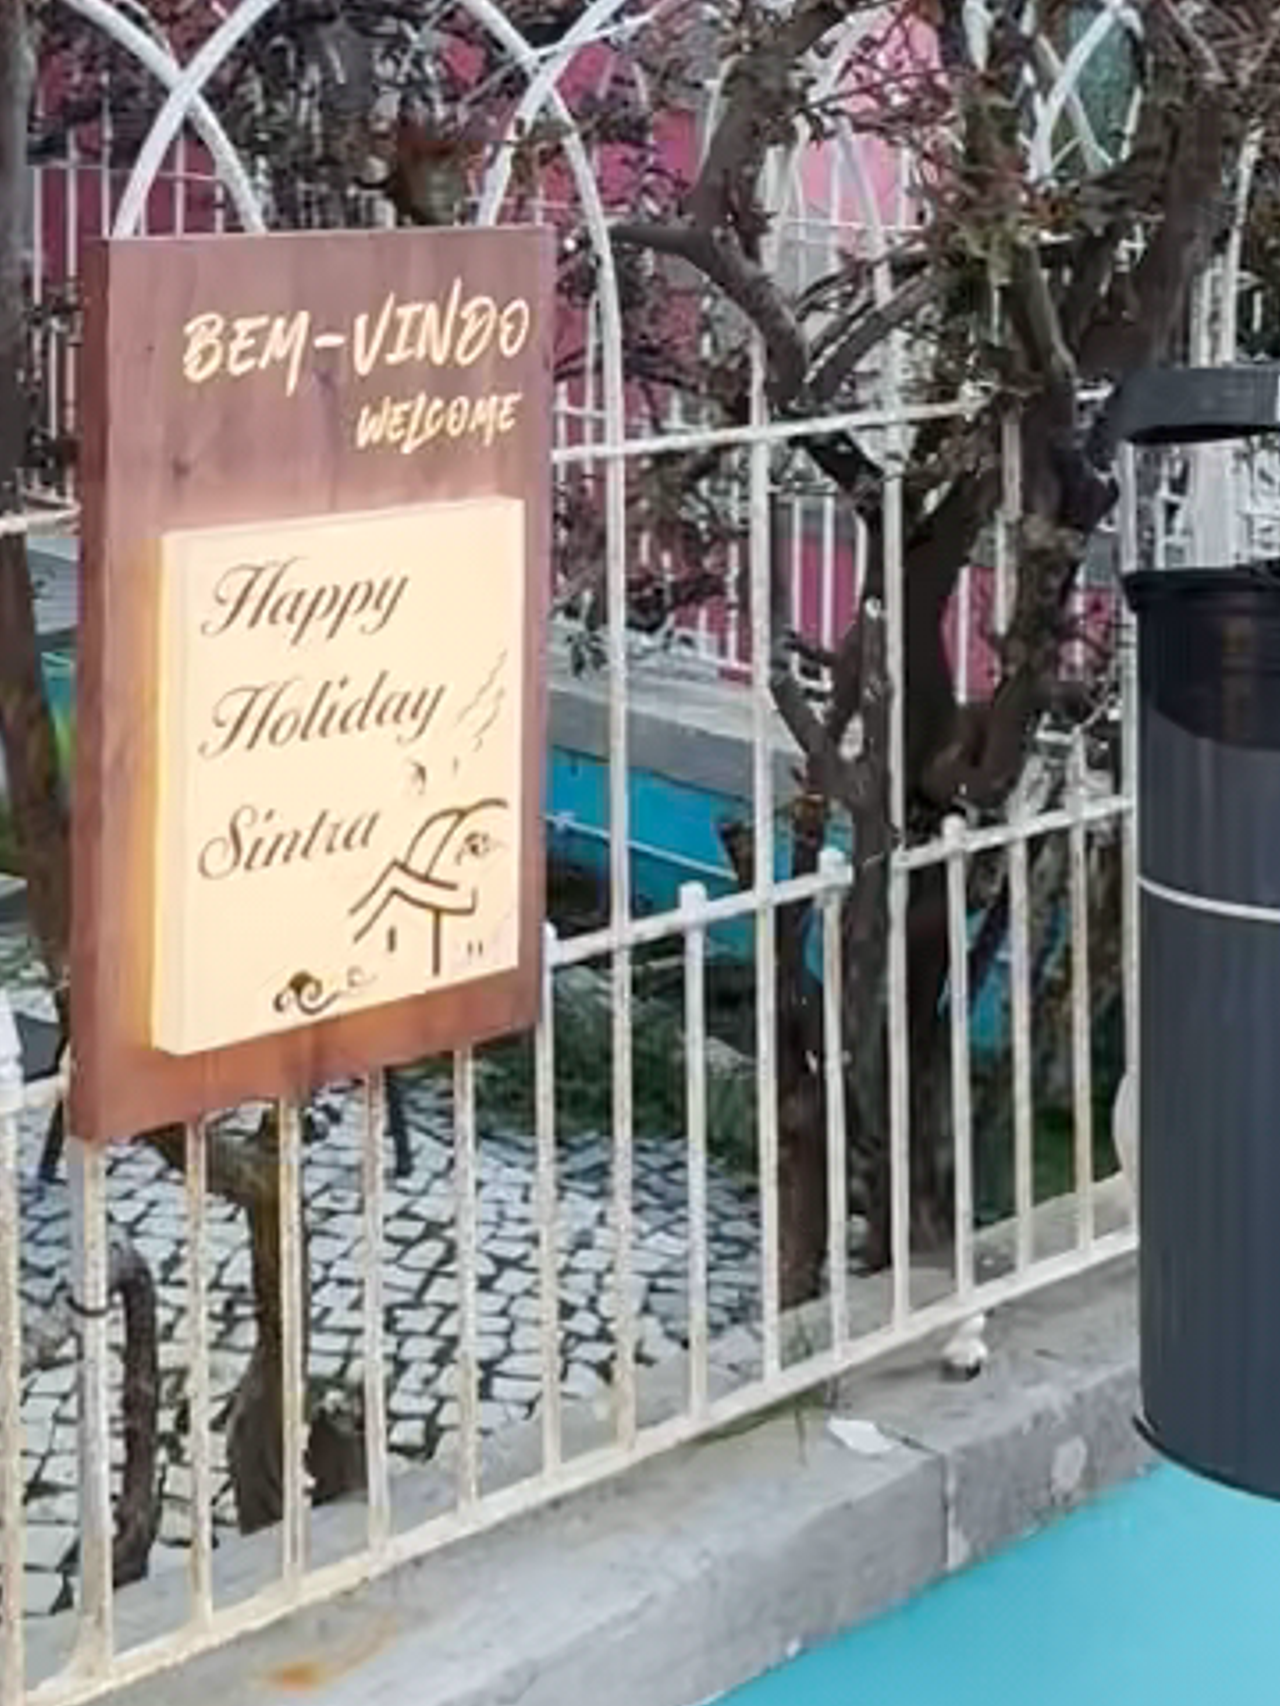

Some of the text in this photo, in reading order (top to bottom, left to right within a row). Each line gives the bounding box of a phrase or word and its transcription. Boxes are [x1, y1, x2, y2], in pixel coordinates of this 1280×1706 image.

[183, 277, 530, 396] BEM-VINDO
[357, 392, 520, 454] WELCOME
[201, 556, 409, 647] Happy
[199, 670, 447, 760] Holiday
[199, 804, 380, 881] Sintra
